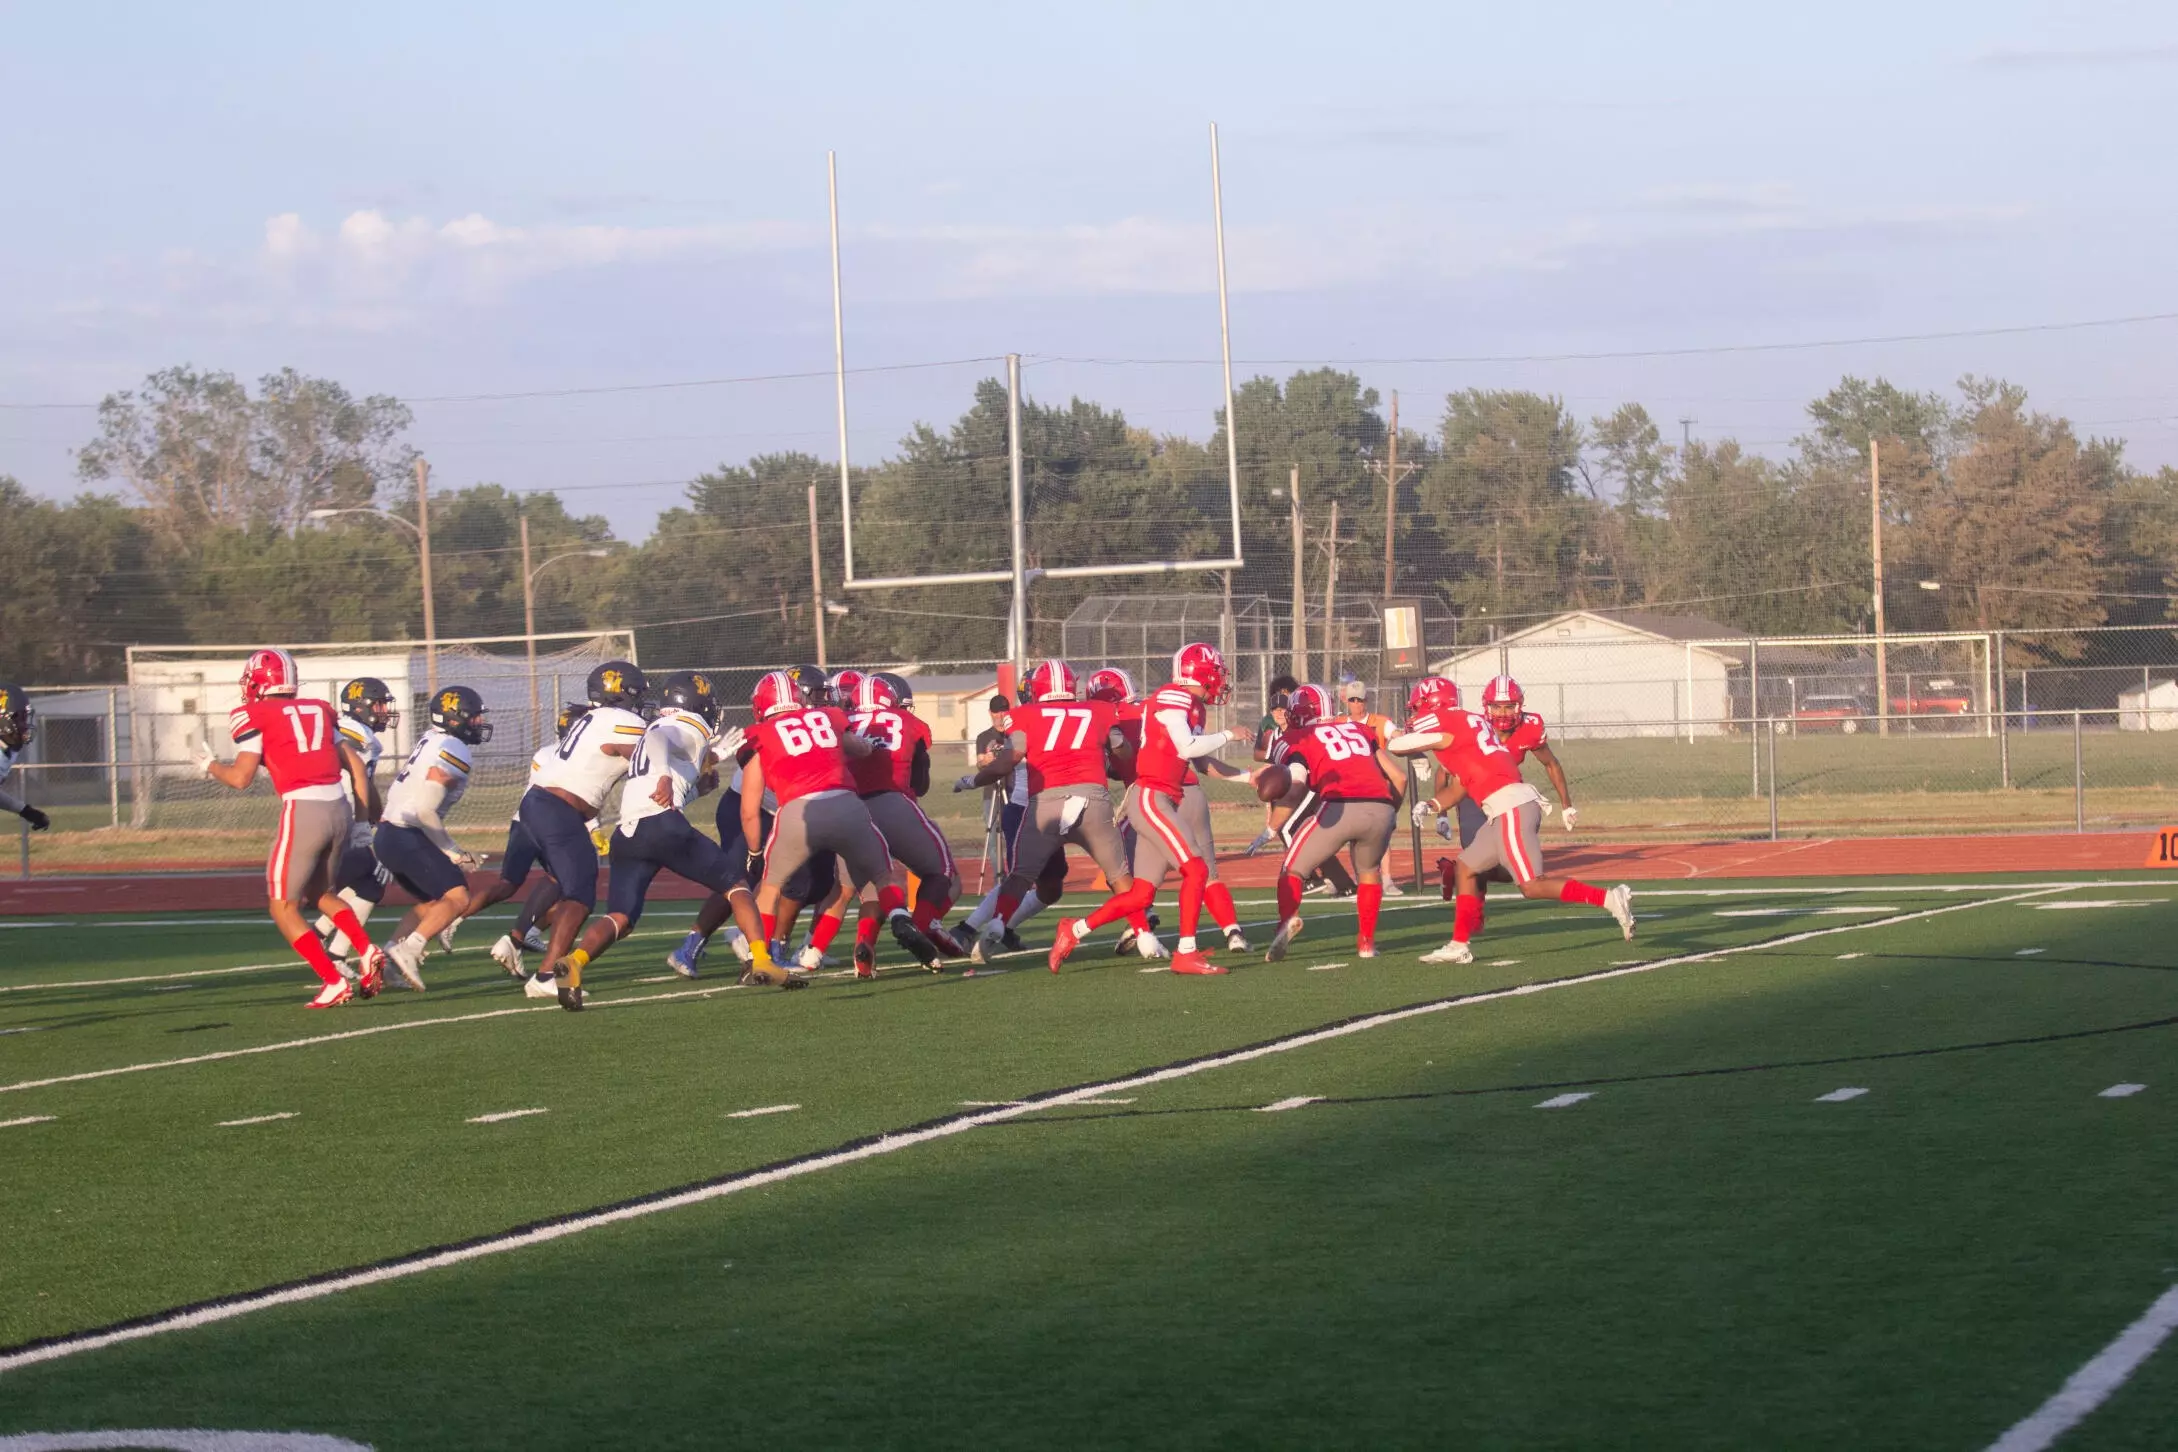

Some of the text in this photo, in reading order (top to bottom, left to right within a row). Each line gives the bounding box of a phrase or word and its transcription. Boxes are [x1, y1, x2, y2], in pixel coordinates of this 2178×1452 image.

[1200, 646, 1221, 666] M
[1419, 679, 1441, 698] M
[282, 705, 325, 753] 17
[775, 711, 838, 757] 68
[848, 711, 903, 751] 73
[1041, 708, 1093, 752] 77
[1314, 721, 1371, 761] 85
